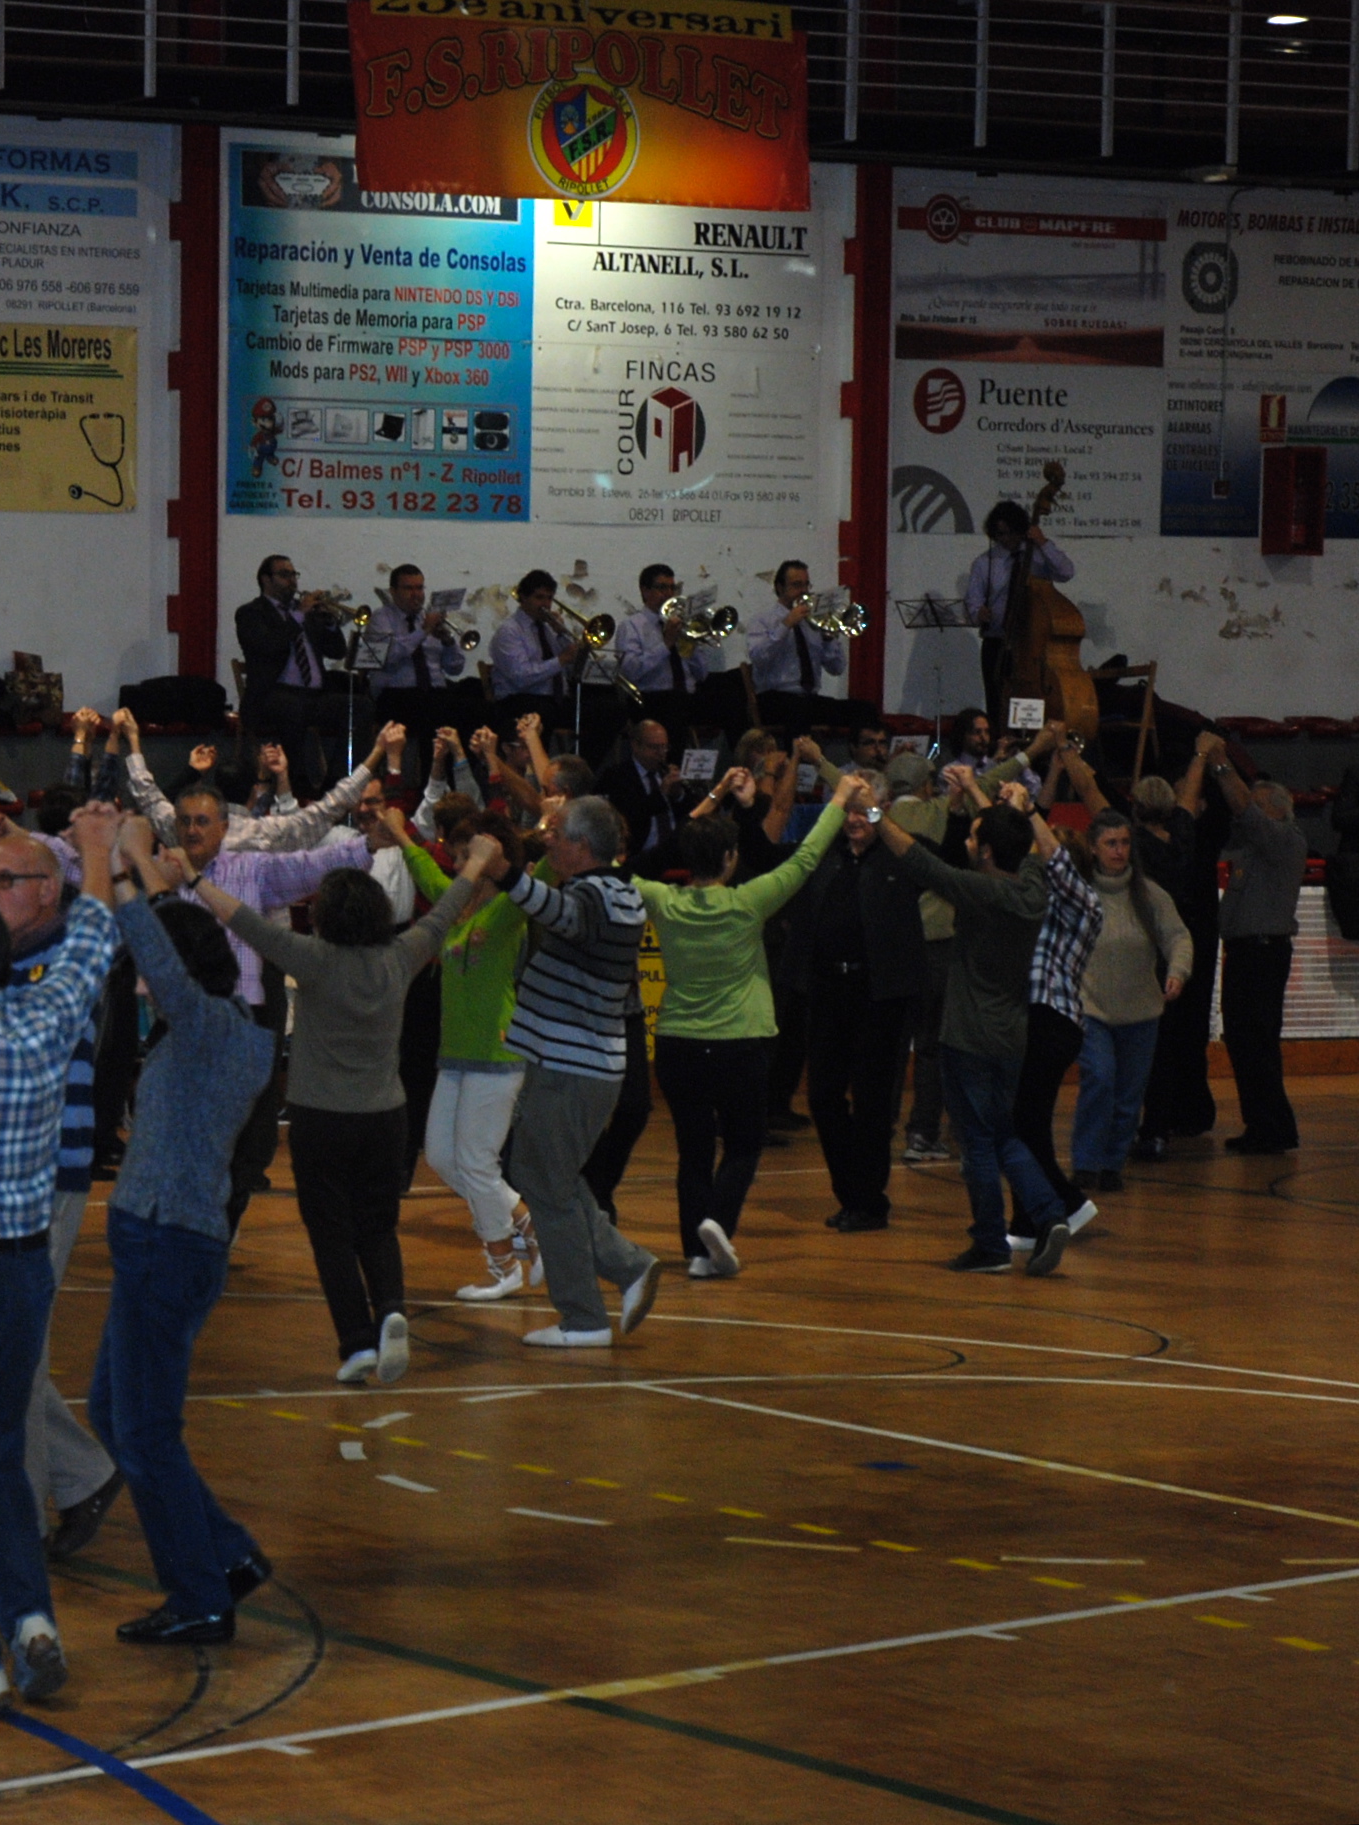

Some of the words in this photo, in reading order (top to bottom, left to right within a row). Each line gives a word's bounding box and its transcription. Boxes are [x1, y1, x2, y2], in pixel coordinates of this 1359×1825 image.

[498, 0, 782, 38] aniversari
[48, 196, 104, 213] S.C.P.
[361, 190, 501, 216] CONSOLA.COM
[694, 222, 808, 250] RENAULT
[975, 216, 1020, 229] CLUB
[1039, 219, 1116, 233] MAPFRE
[1248, 214, 1302, 232] BOMBAS
[234, 238, 338, 264] Reparación
[343, 248, 354, 270] y
[361, 244, 412, 267] Venta
[419, 248, 440, 267] de
[447, 248, 526, 273] Consolas
[593, 252, 704, 278] ALTANELL,
[711, 257, 749, 278] S.L.
[236, 278, 285, 296] Tarjetas
[290, 282, 358, 300] Multimedia
[363, 289, 390, 305] para
[394, 287, 462, 304] NINTENDO
[466, 290, 482, 305] DS
[273, 305, 329, 326] Tarjetas
[334, 308, 350, 326] de
[355, 309, 417, 329] Memoria
[422, 315, 453, 333] para
[457, 313, 485, 330] PSP
[555, 298, 585, 310] Ctra.
[591, 300, 655, 315] Barcelona,
[661, 302, 684, 314] 116
[690, 304, 710, 316] Tel.
[716, 305, 730, 316] 93
[737, 305, 760, 317] 692
[766, 307, 780, 318] 19
[787, 307, 801, 319] 12
[568, 320, 581, 332] C/
[620, 323, 659, 337] Josep,
[677, 325, 697, 337] Tel.
[703, 326, 717, 337] 93
[724, 327, 747, 338] 580
[752, 328, 767, 339] 62
[773, 328, 789, 340] 50
[14, 329, 40, 358] Les
[47, 330, 112, 360] Moreres
[246, 333, 301, 351] Cambio
[306, 336, 324, 351] de
[328, 336, 393, 355] Firmware
[398, 339, 427, 356] PSP
[444, 340, 473, 357] PSP
[477, 343, 510, 359] 3000
[270, 361, 308, 379] Mods
[314, 365, 344, 383] para
[349, 364, 381, 384] PS2,
[425, 367, 460, 385] Xbox
[465, 370, 489, 386] 360
[626, 360, 715, 382] FINCAS
[979, 379, 1068, 408] Puente
[617, 389, 635, 475] COUR
[978, 417, 1045, 432] Corredors
[1051, 419, 1154, 438] d'Assegurances
[282, 459, 303, 479] C/
[310, 460, 383, 481] Balmes
[462, 469, 521, 487] Ripollet
[281, 489, 330, 509] Tel.
[342, 491, 375, 510] 93
[387, 492, 435, 511] 182
[447, 493, 479, 512] 23
[491, 494, 521, 513] 78
